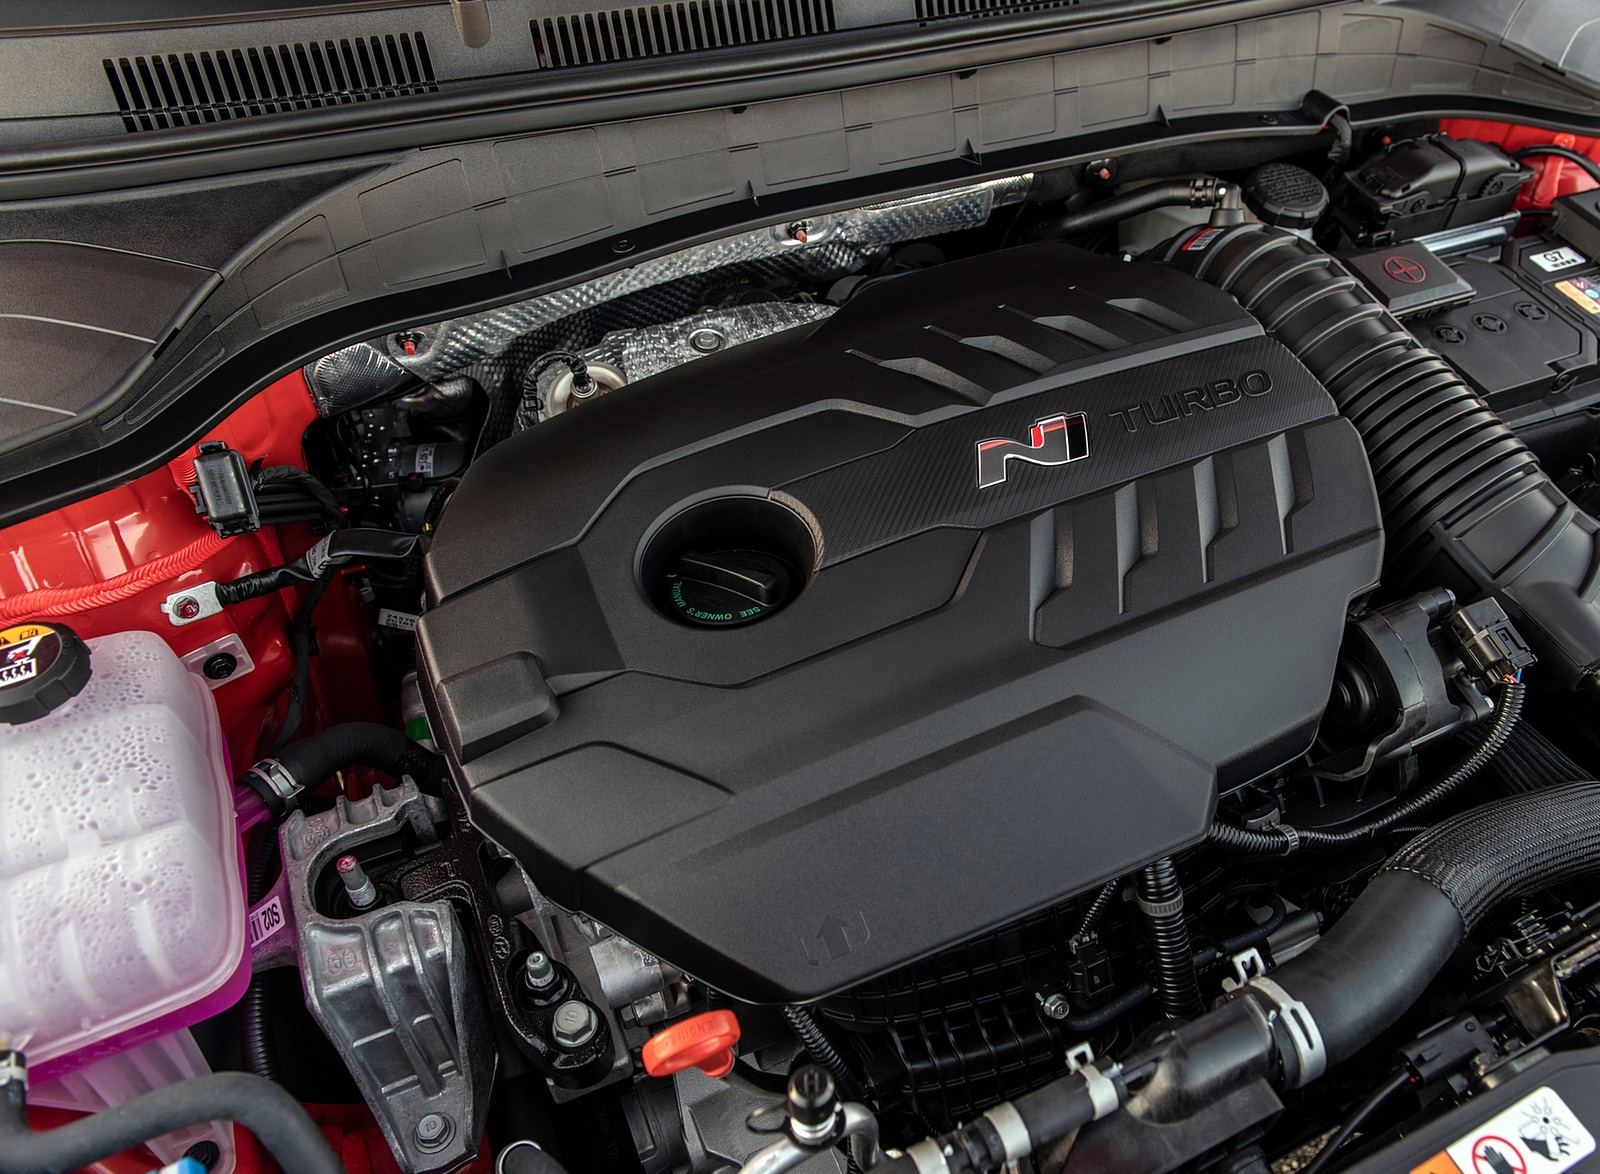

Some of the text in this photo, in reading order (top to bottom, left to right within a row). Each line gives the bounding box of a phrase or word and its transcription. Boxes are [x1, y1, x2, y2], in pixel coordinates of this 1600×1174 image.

[1543, 251, 1564, 262] G7
[1108, 369, 1273, 433] TURBO
[671, 581, 761, 620] SEE OWNER'S MANUAL
[261, 903, 280, 931] S02
